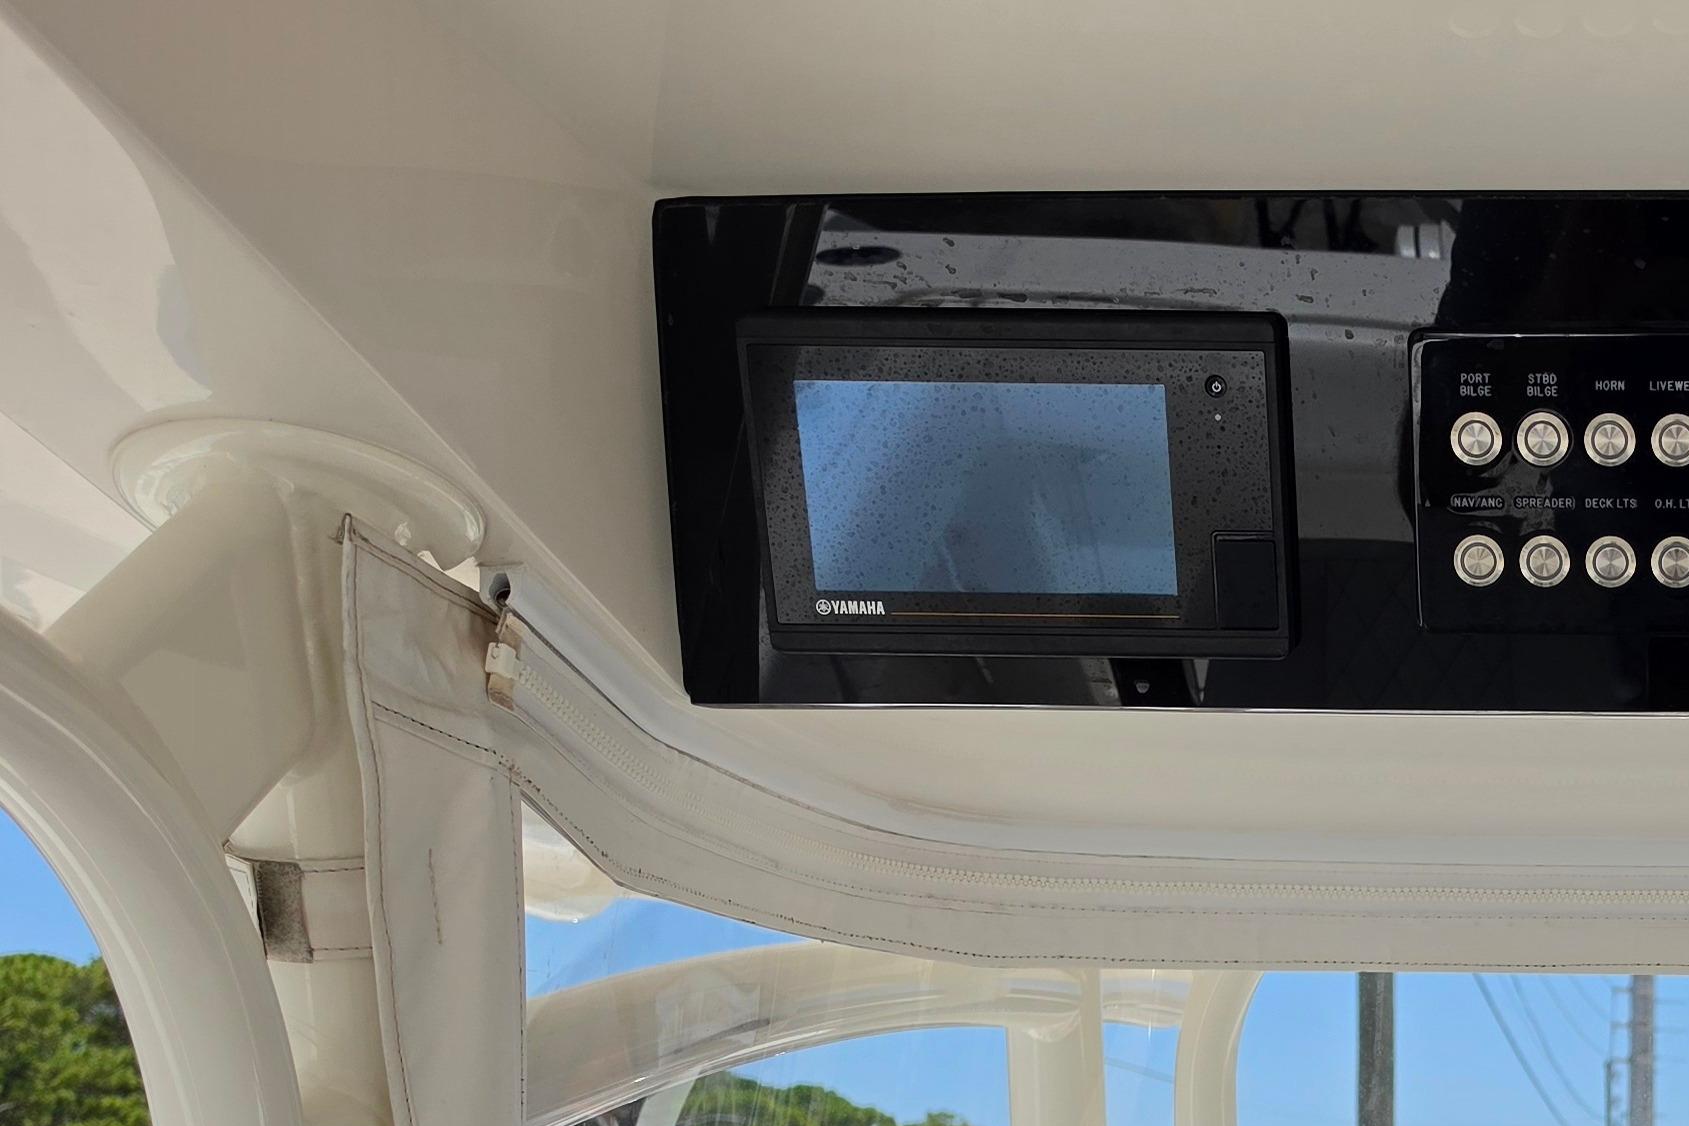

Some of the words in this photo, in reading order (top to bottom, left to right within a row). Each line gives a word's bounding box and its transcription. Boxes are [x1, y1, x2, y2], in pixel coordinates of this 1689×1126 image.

[1460, 373, 1491, 384] PORT
[1527, 373, 1558, 384] STBD
[1595, 380, 1625, 391] HORN
[1459, 386, 1492, 397] BILGE
[1526, 386, 1558, 397] BILGE
[1453, 497, 1504, 508] NAV/ANC
[1515, 497, 1573, 509] SPREADER
[1585, 498, 1614, 509] DECK
[1616, 498, 1637, 509] LTS
[1655, 499, 1677, 509] O.H.
[831, 600, 886, 615] YAMAHA
